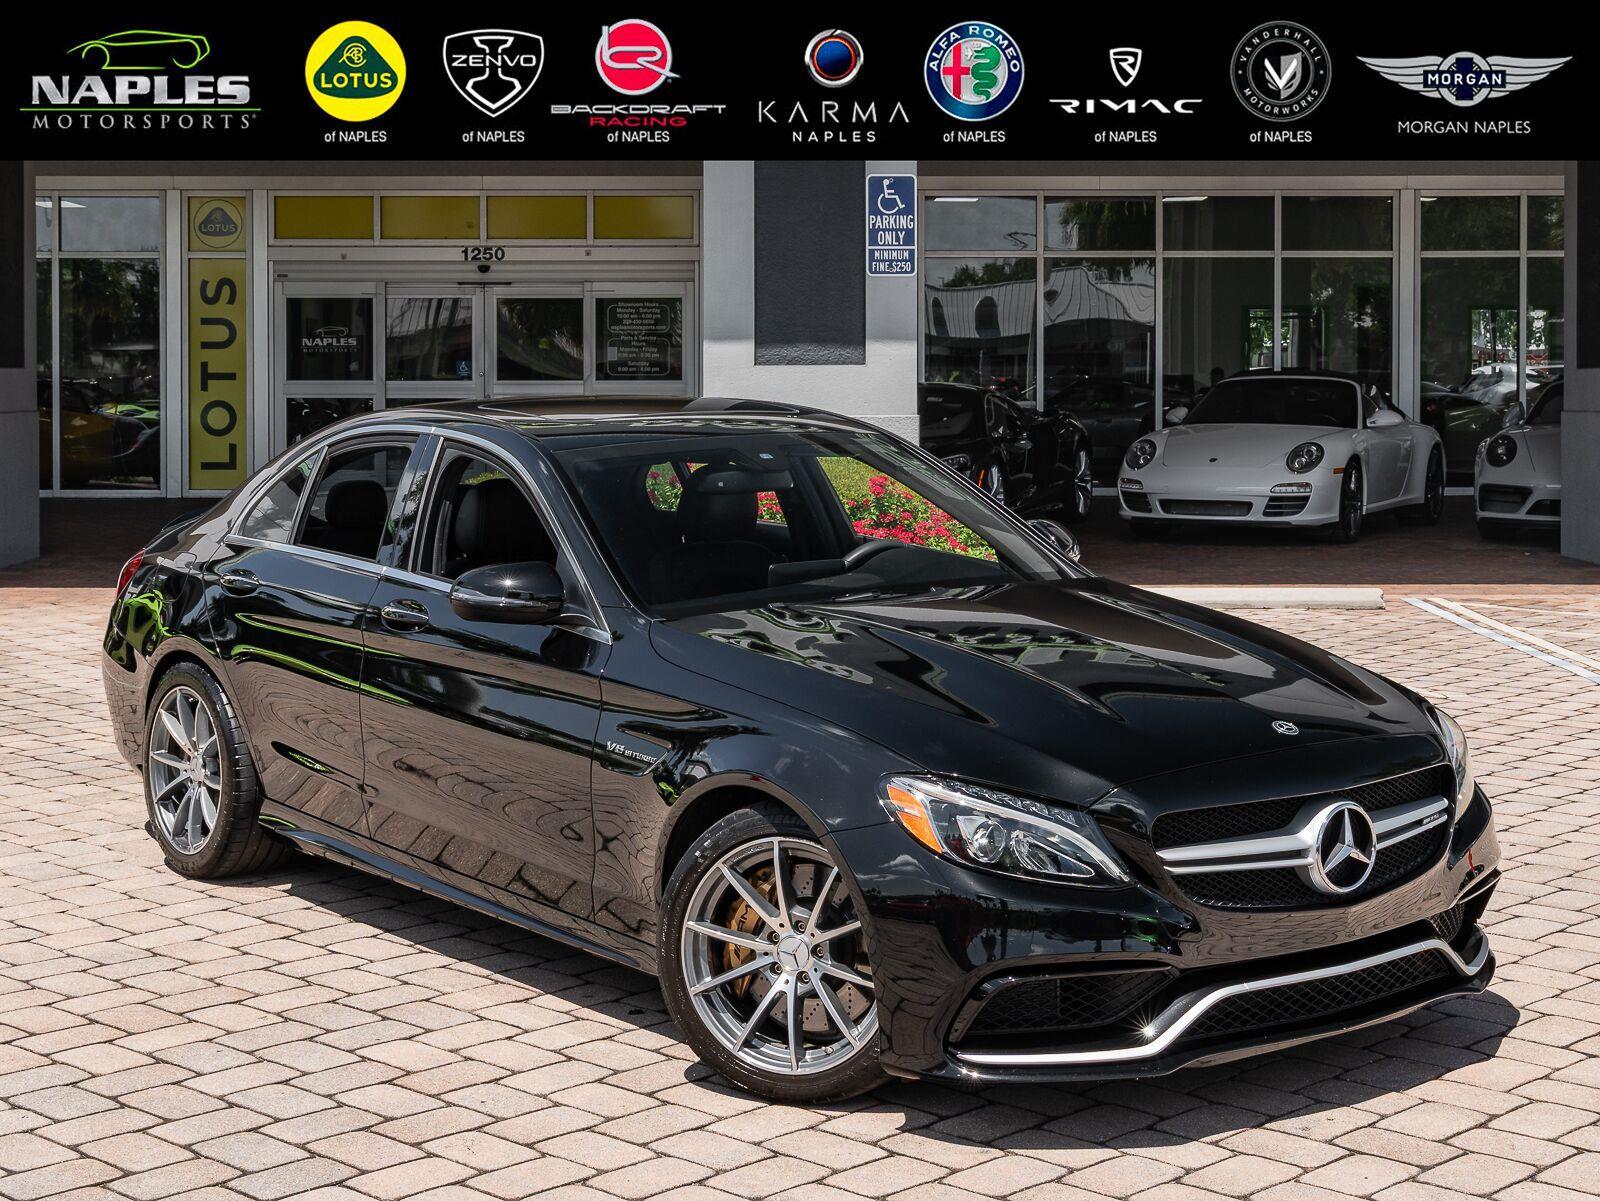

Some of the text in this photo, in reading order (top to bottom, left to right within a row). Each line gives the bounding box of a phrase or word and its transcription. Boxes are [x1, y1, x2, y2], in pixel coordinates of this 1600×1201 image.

[201, 223, 236, 233] LOTUS
[869, 215, 914, 229] PARKING
[877, 231, 906, 245] ONLY
[461, 246, 506, 261] 1250
[874, 250, 909, 260] MINIMUM
[872, 261, 912, 272] FINE $250
[302, 337, 357, 346] NAPLES
[200, 276, 238, 471] LOTUS
[606, 741, 625, 754] V8
